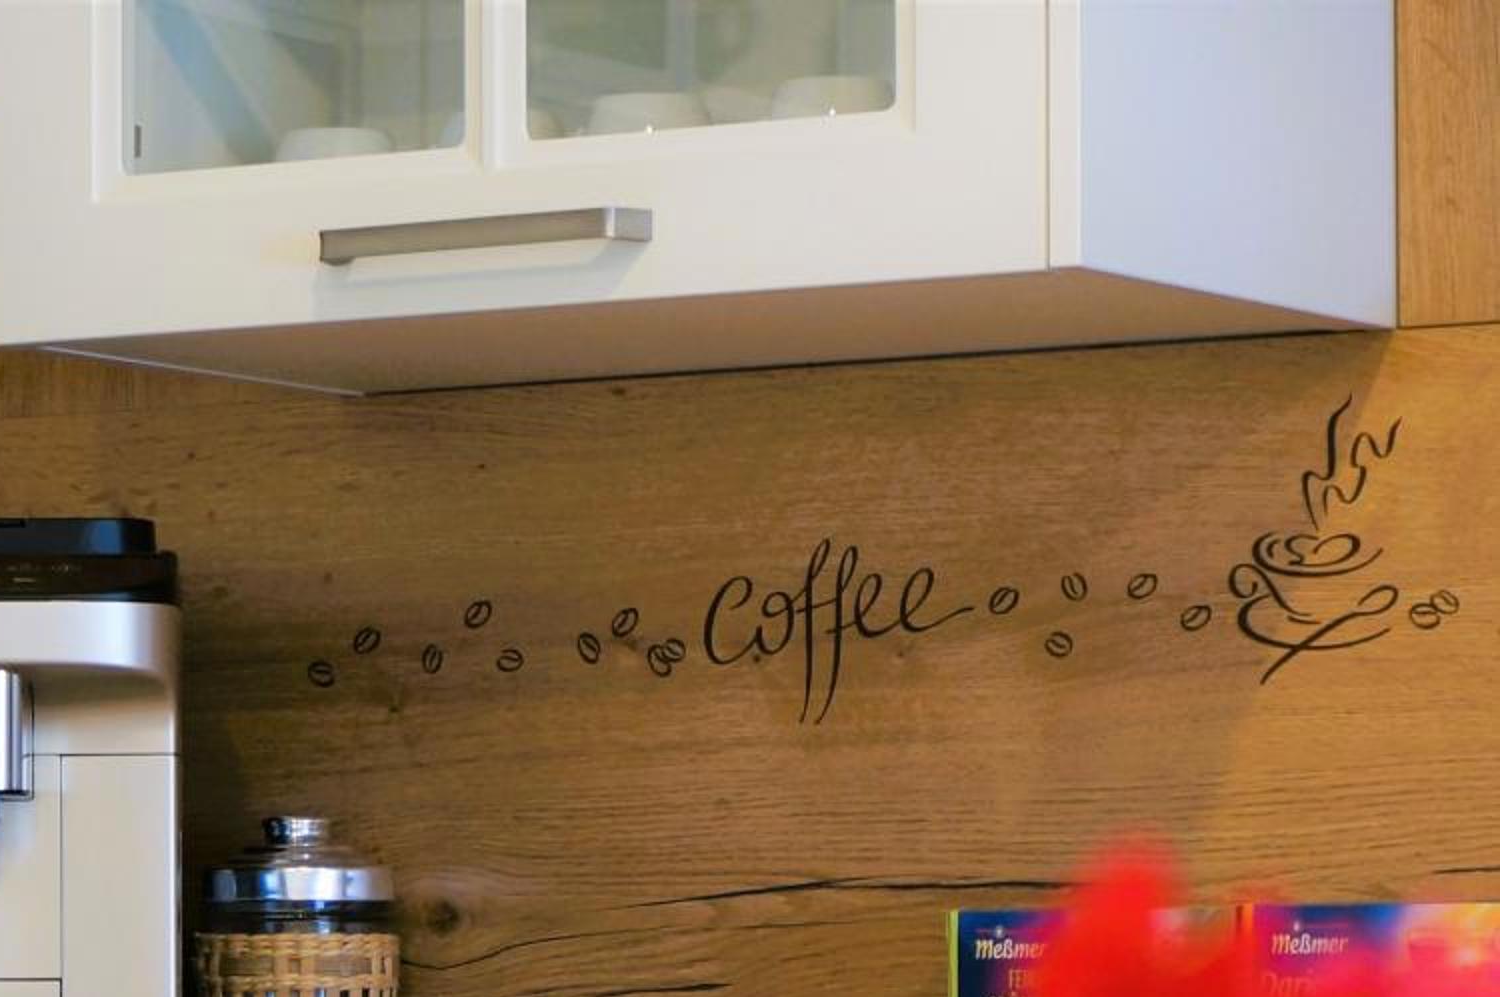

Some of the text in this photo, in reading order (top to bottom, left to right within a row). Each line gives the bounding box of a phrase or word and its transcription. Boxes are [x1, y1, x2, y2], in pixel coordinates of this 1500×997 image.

[703, 538, 974, 724] Coffee
[975, 938, 1047, 960] Meßmer
[1271, 933, 1349, 955] Meßmer
